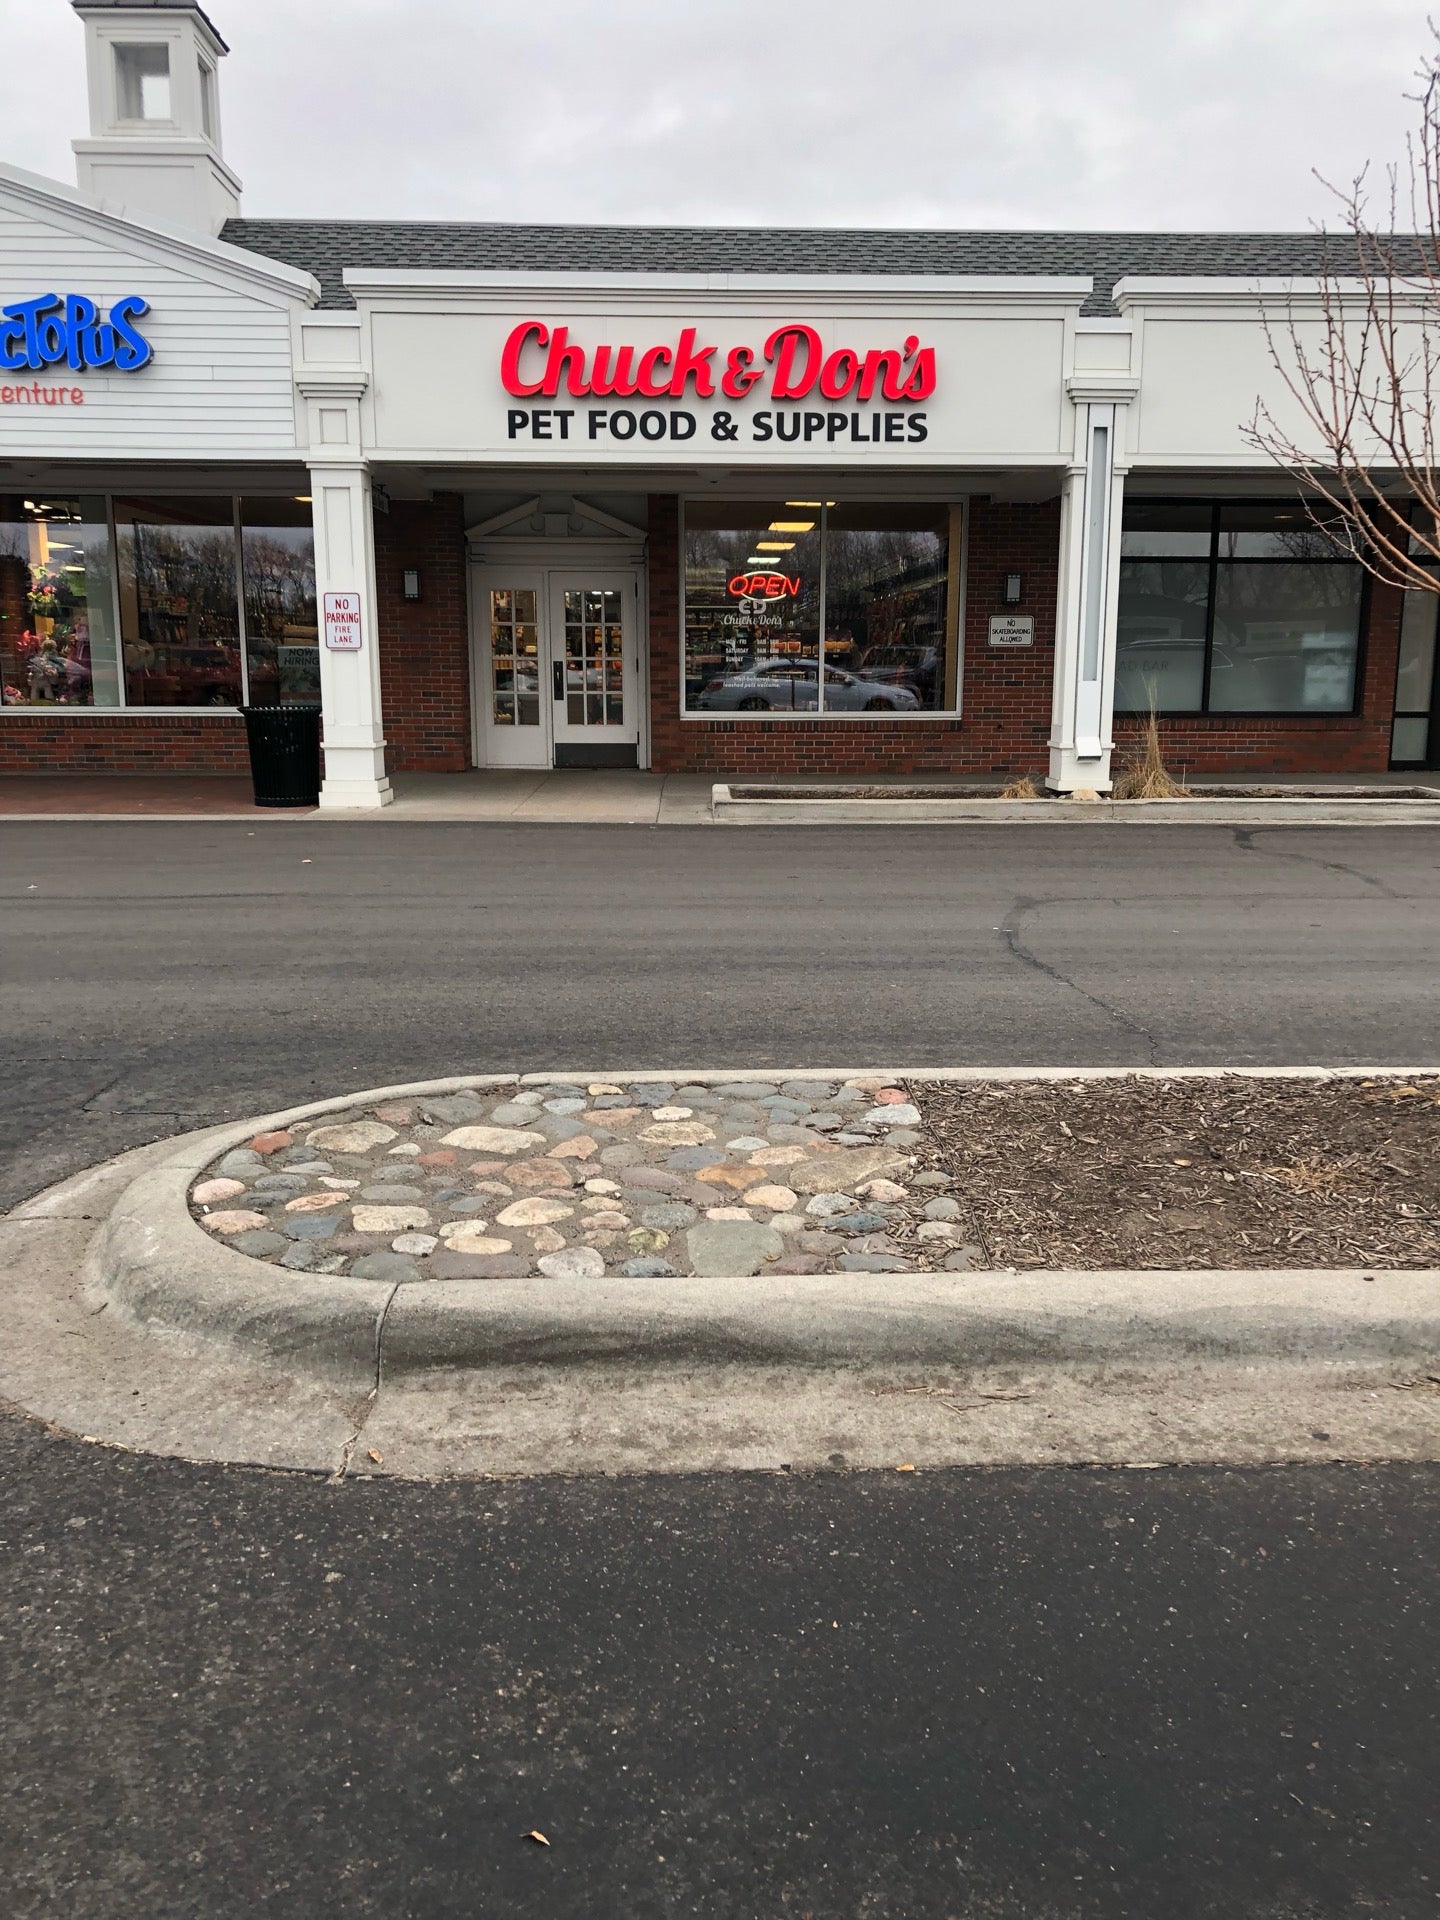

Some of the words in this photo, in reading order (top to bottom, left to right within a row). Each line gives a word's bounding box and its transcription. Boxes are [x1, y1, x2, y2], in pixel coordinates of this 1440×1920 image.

[500, 321, 718, 398] Chuck
[721, 346, 765, 399] &
[763, 324, 937, 402] Don's
[508, 410, 574, 439] PET
[588, 410, 697, 441] FOOD
[711, 411, 739, 441] &
[752, 411, 928, 443] SUPPLIES
[728, 575, 800, 597] OPEN
[335, 599, 348, 610] NO
[326, 612, 358, 624] PARKING
[1007, 619, 1016, 627] NO
[334, 625, 352, 633] FIRE
[334, 635, 353, 643] LANE
[288, 648, 314, 656] NOW
[284, 657, 319, 665] HIRING
